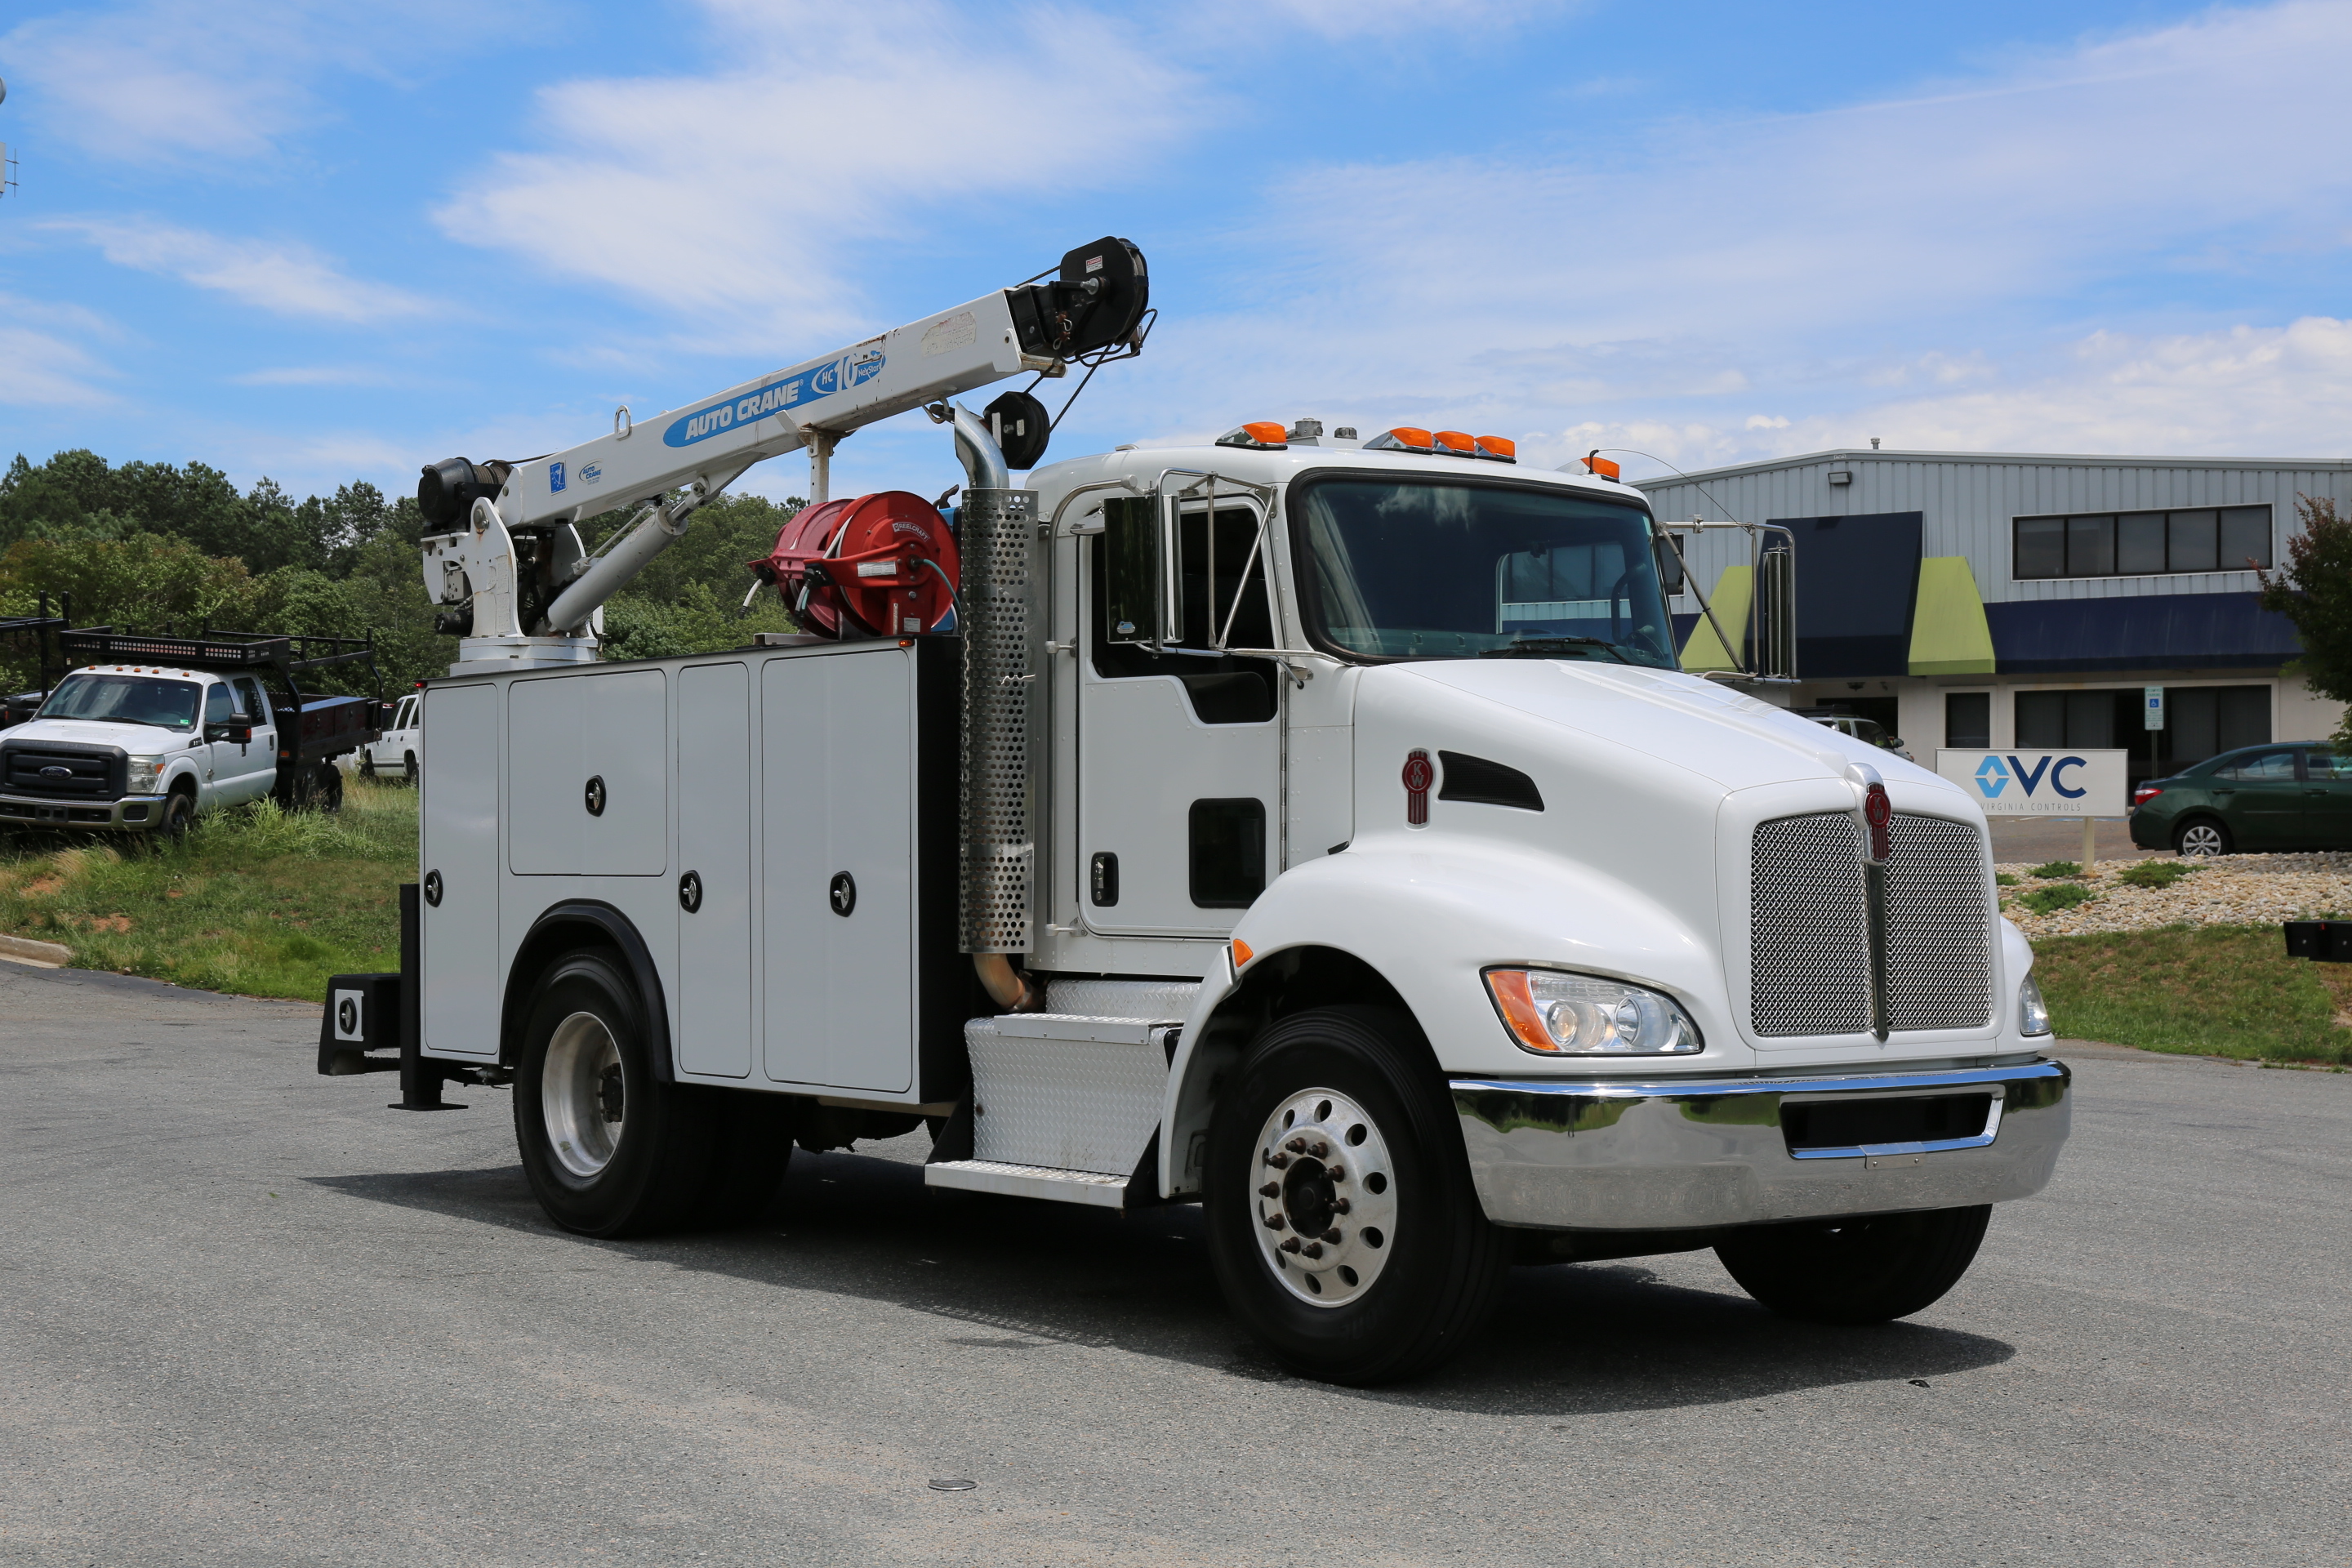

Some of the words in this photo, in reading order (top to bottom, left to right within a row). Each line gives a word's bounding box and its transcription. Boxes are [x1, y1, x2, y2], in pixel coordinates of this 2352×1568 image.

[822, 371, 833, 385] HC
[834, 353, 858, 392] 10
[684, 405, 733, 441] AUTO
[582, 466, 595, 474] AUTO
[586, 469, 602, 479] CRANE
[898, 523, 929, 540] REELCRAFT
[46, 768, 64, 777] Ford
[2007, 755, 2087, 799] VC
[1981, 803, 2025, 811] VIRGINIA
[2031, 803, 2081, 811] CONTROLS
